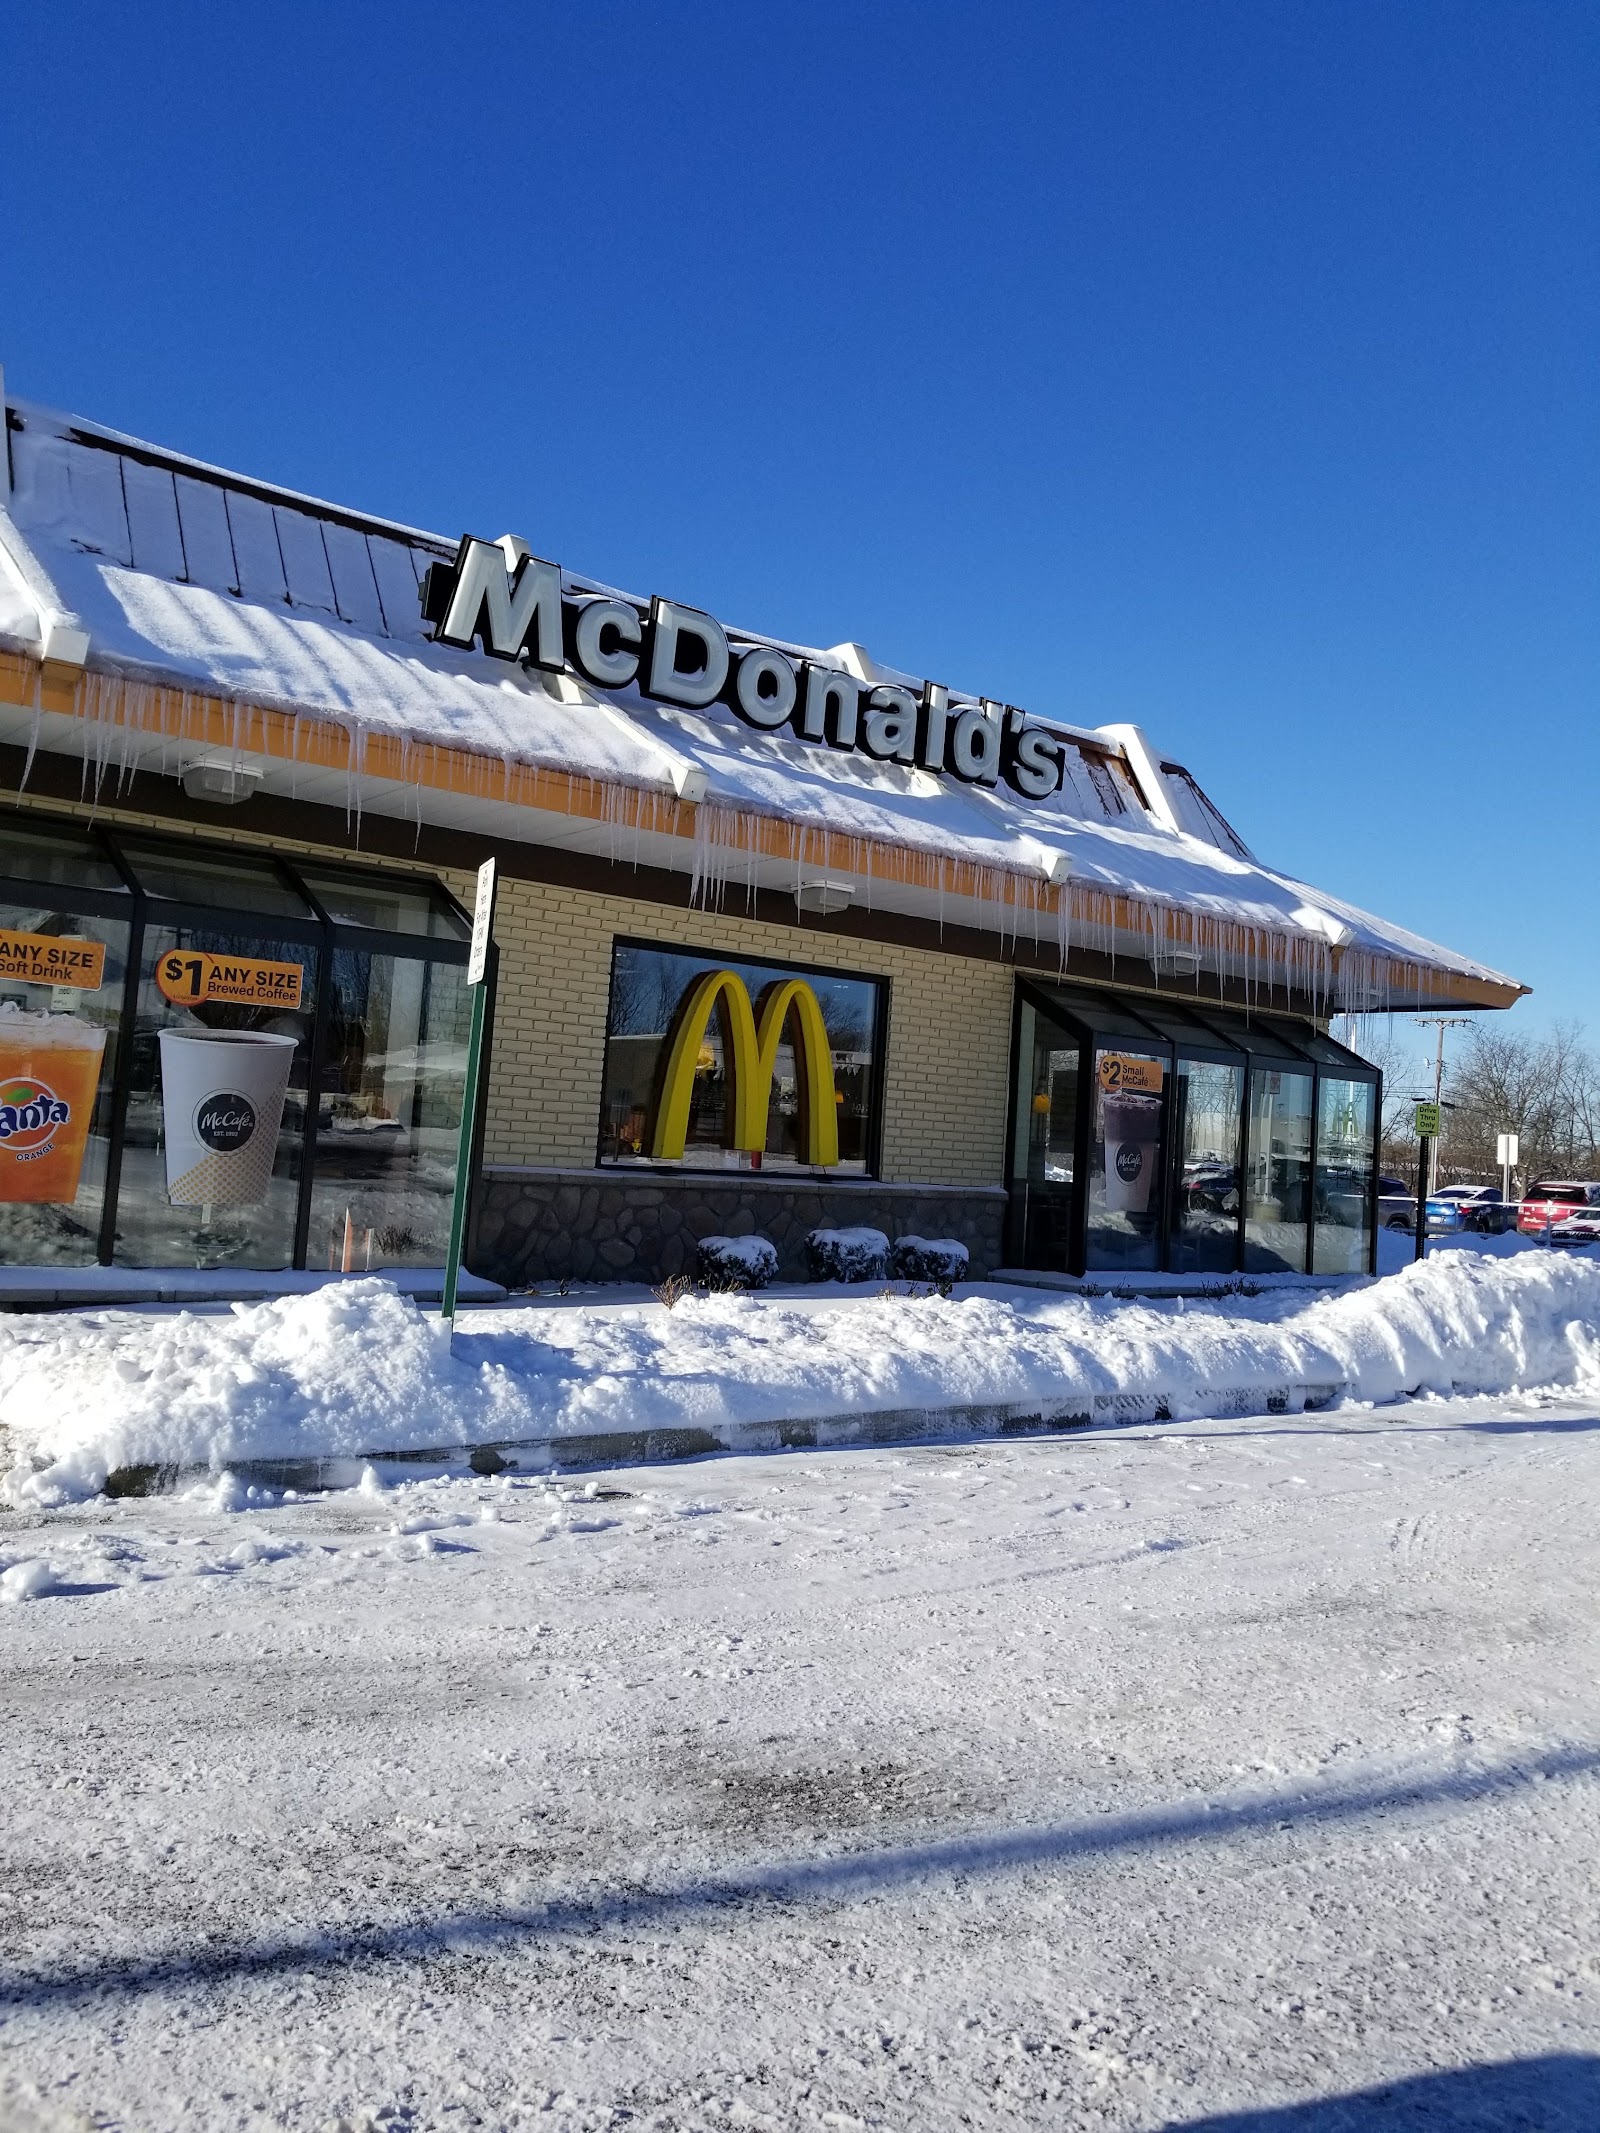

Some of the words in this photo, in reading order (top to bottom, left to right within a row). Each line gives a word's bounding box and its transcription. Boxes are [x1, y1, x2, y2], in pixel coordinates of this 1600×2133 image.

[437, 533, 1064, 799] McDonald's
[0, 942, 42, 960] ANY
[47, 949, 94, 968] SIZE
[0, 958, 28, 974] Soft
[31, 963, 72, 979] Drink
[165, 956, 203, 996] $1
[209, 966, 251, 983] ANY
[256, 971, 298, 988] SIZE
[207, 982, 254, 996] Brewed
[257, 988, 296, 1000] Coffee
[1102, 1061, 1121, 1085] $2
[1122, 1065, 1144, 1076] Small
[1122, 1075, 1149, 1086] McCafé
[0, 1094, 69, 1138] anta
[201, 1111, 250, 1131] McCafé
[1420, 1121, 1435, 1129] Only
[16, 1142, 55, 1161] ORANGE
